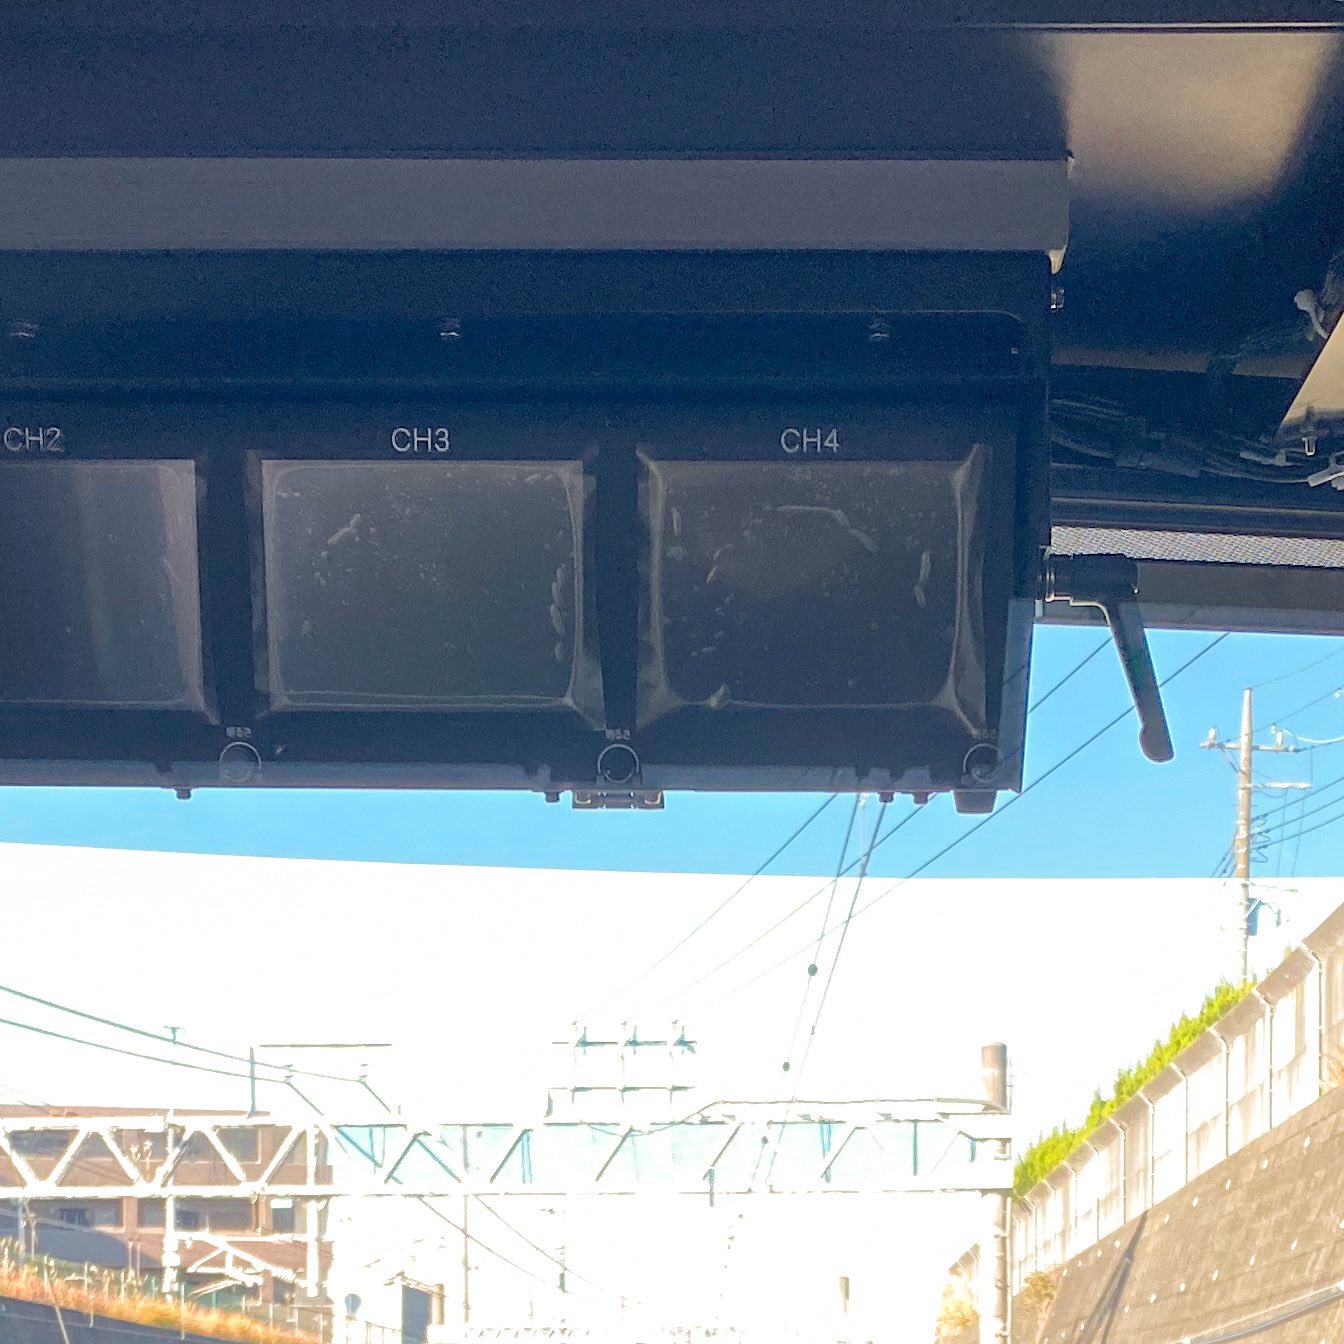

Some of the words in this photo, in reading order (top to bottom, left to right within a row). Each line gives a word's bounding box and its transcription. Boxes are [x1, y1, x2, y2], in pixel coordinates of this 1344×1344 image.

[3, 427, 63, 452] CH2
[391, 428, 449, 452] CH3
[780, 428, 839, 453] CH4
